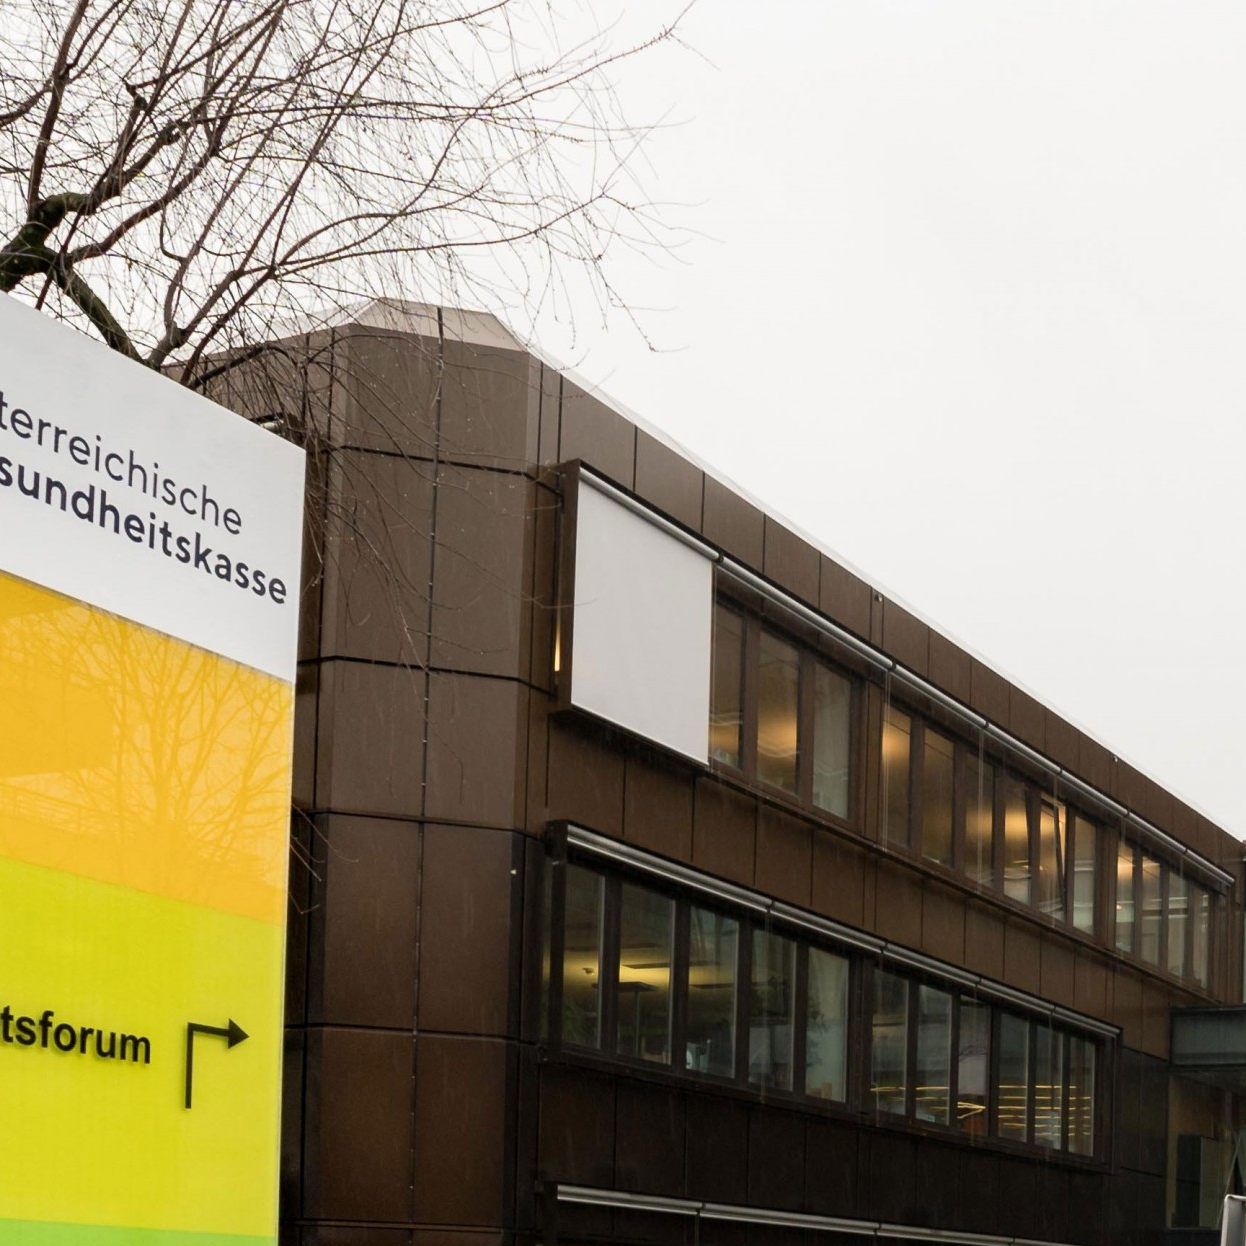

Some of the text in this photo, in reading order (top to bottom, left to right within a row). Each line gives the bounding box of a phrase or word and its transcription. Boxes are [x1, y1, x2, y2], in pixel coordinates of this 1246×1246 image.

[0, 391, 242, 535] terreichische
[0, 456, 287, 604] sundheitskasse
[0, 1005, 151, 1064] tsforum
